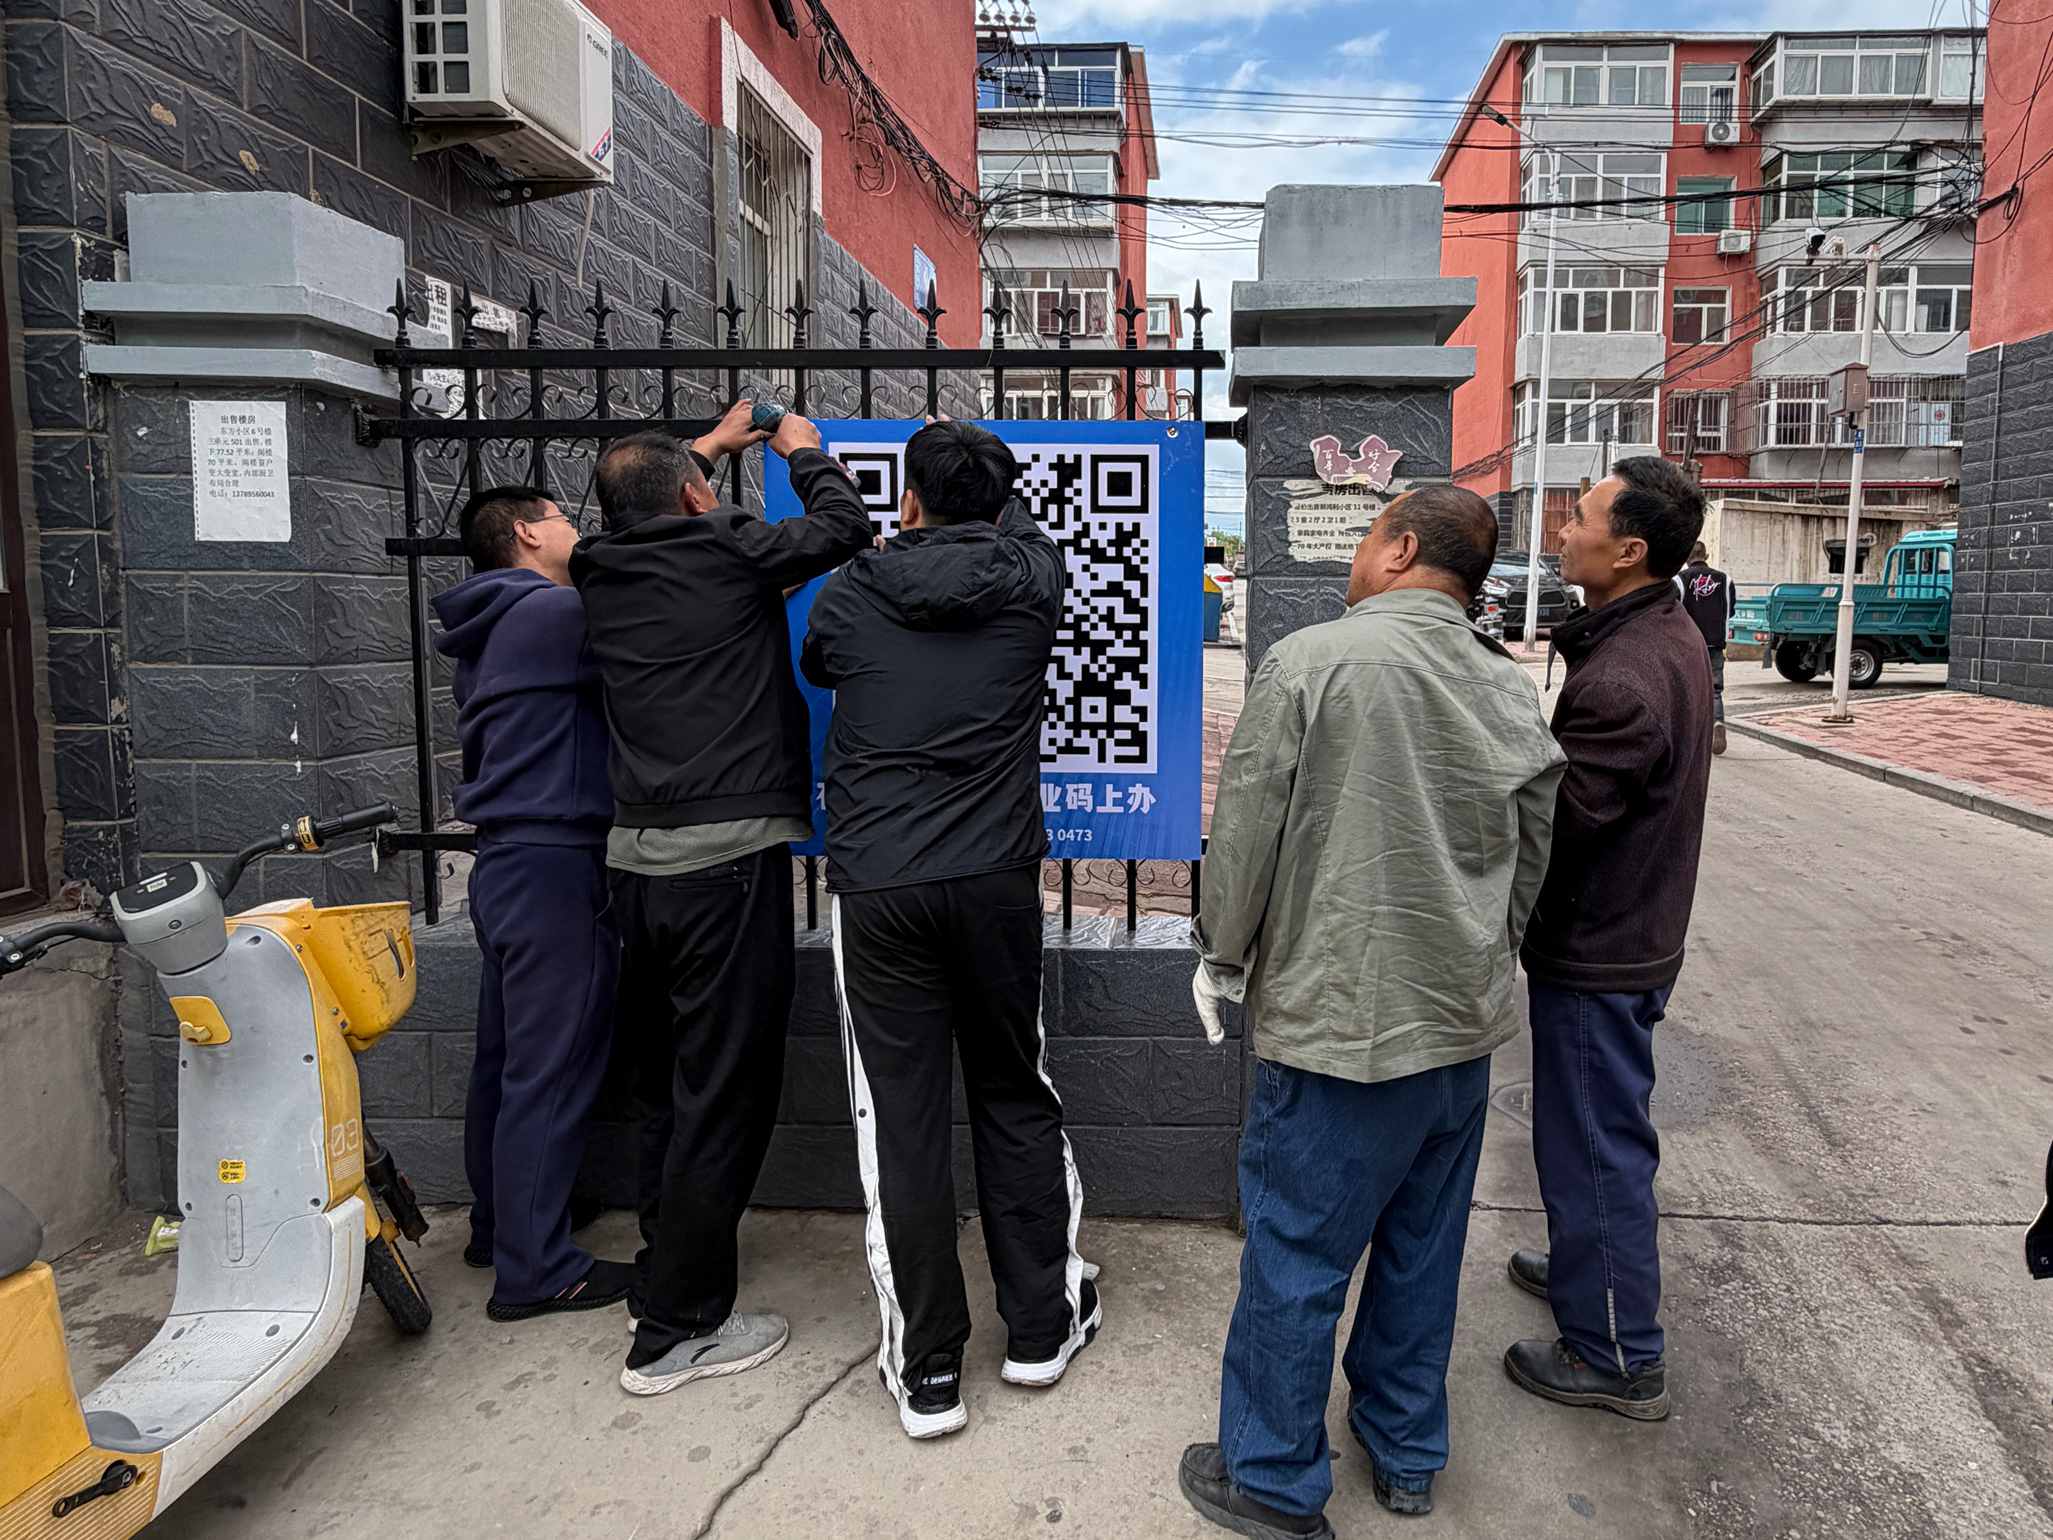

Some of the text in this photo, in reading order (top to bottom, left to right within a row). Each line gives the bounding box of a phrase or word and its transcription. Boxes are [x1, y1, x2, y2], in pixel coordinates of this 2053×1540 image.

[221, 414, 256, 425] 出售楼房
[1040, 783, 1157, 814] 业码上办
[1057, 828, 1093, 841] 0473
